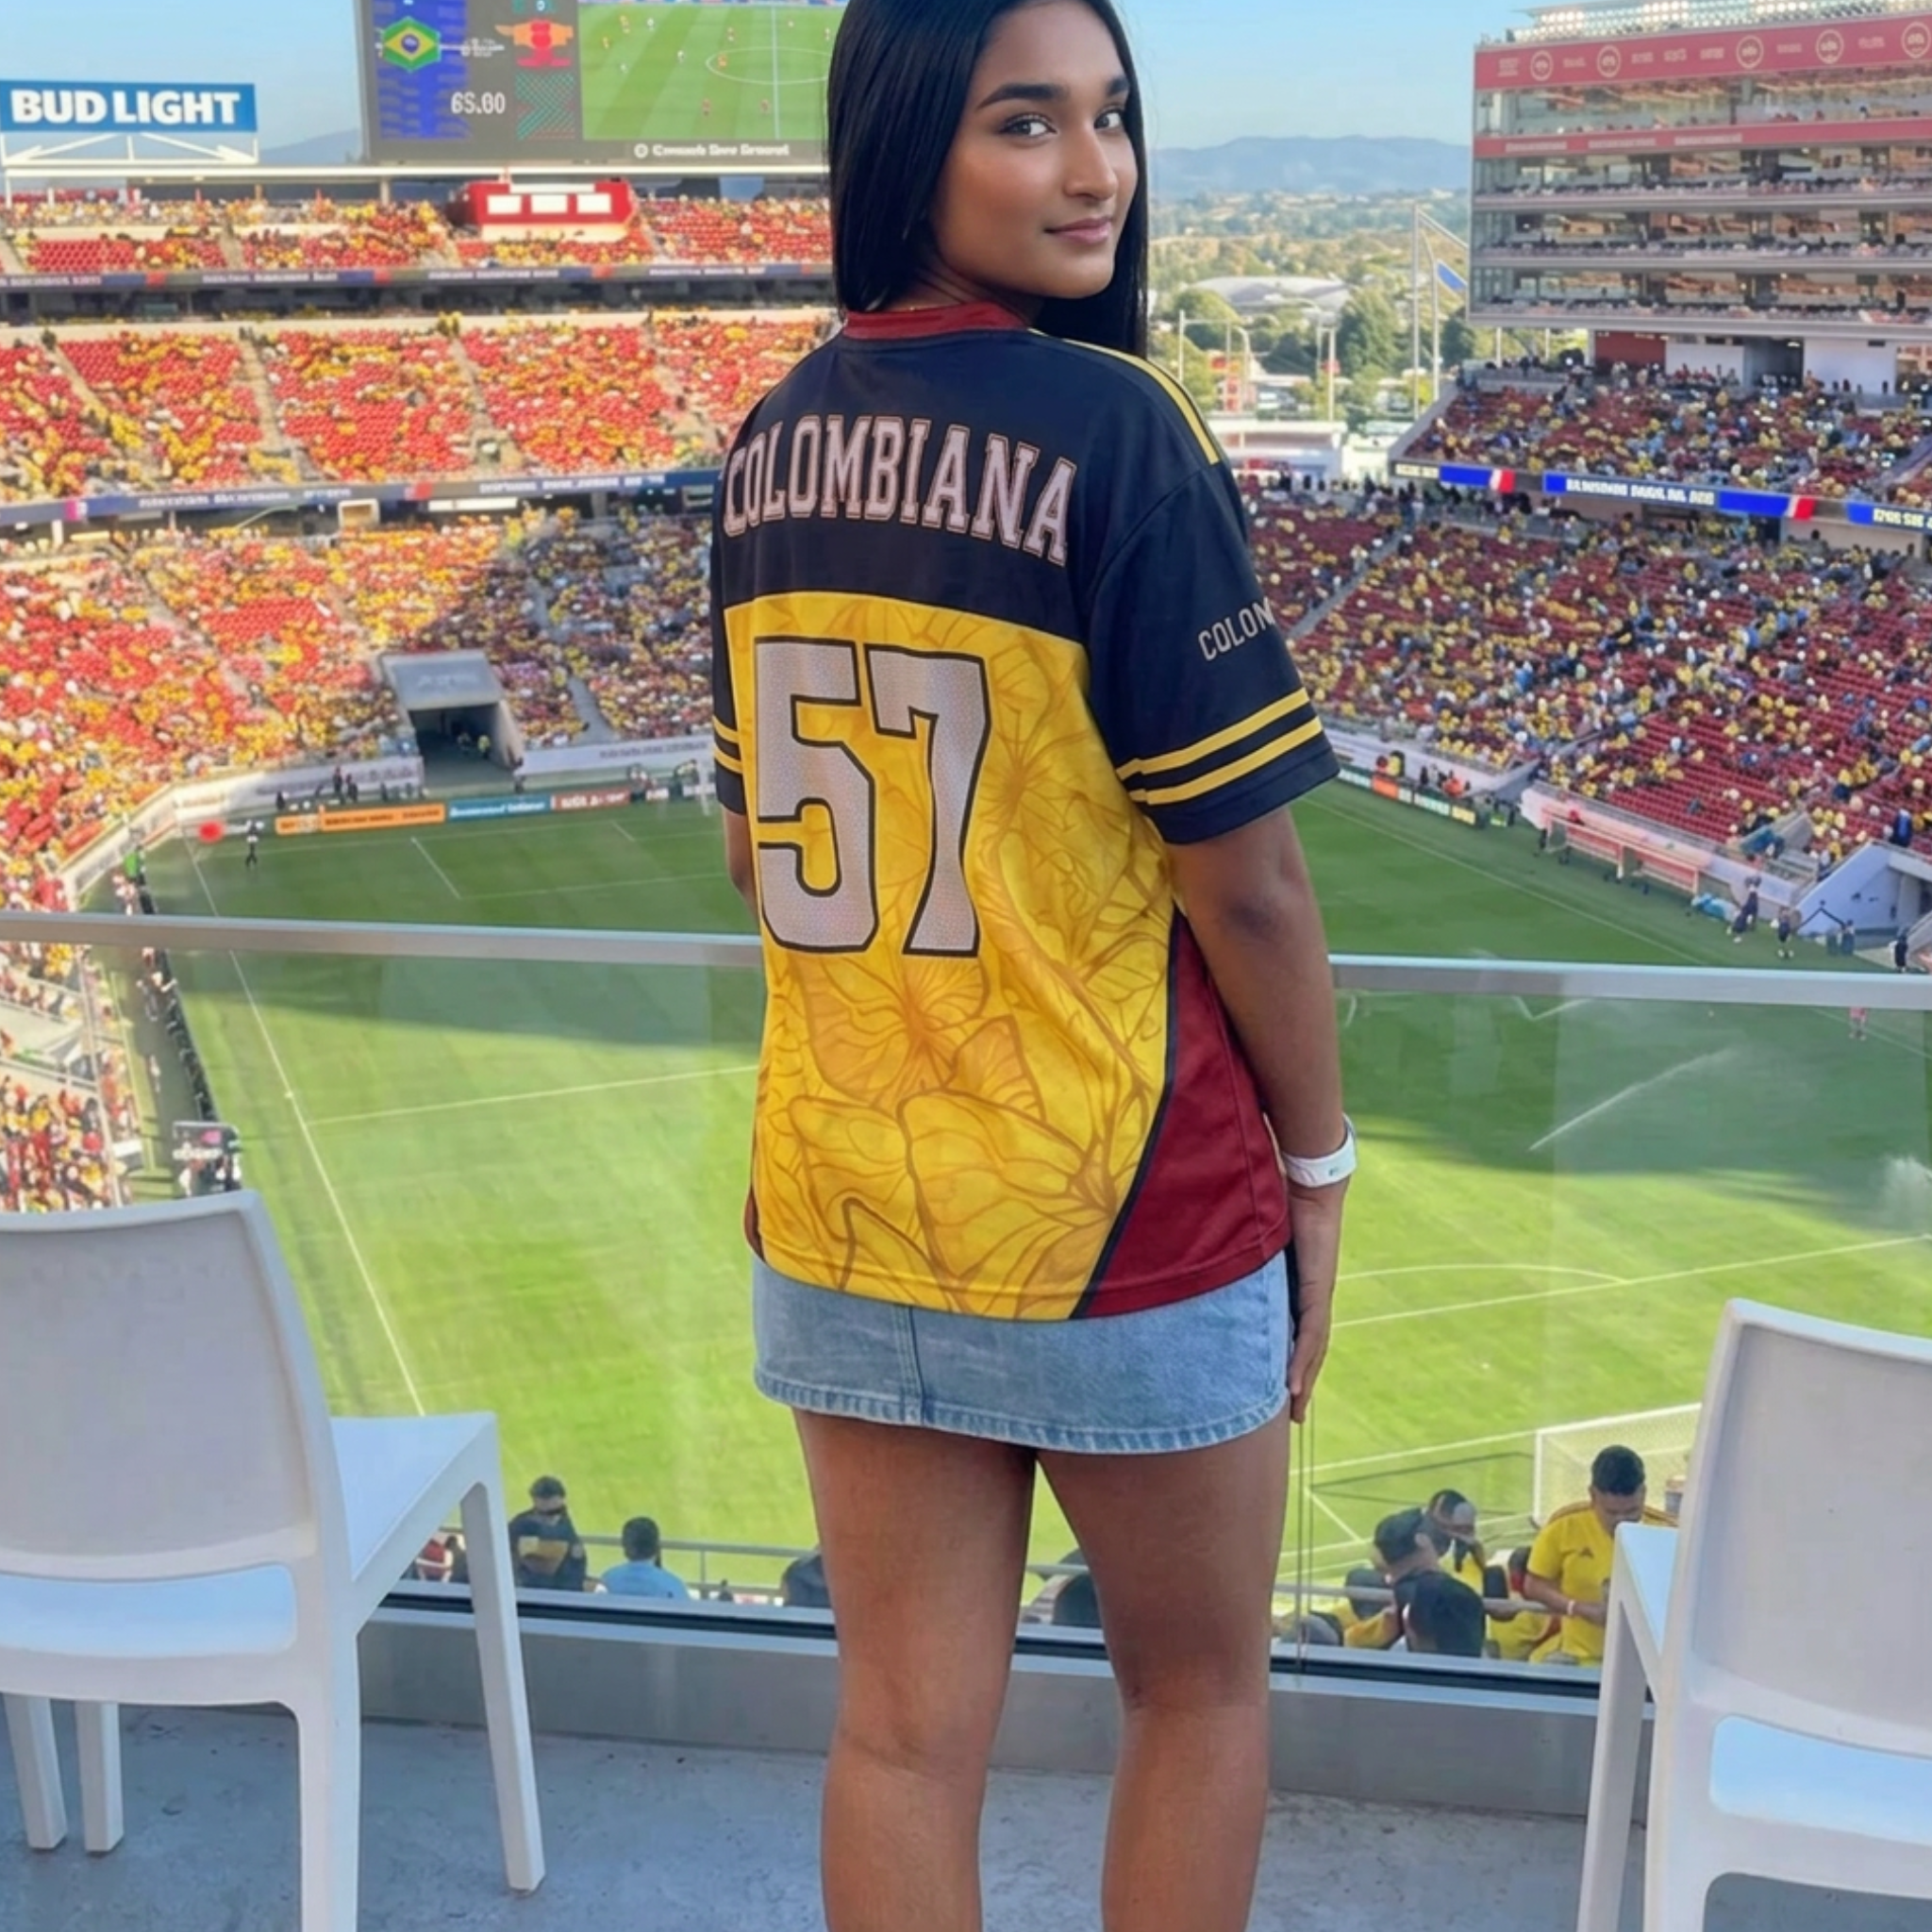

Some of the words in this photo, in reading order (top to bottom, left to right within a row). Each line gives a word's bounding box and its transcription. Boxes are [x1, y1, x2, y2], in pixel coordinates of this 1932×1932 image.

[10, 90, 108, 124] BUD
[112, 91, 241, 125] LIGHT
[723, 413, 1077, 567] COLOMBIANA
[755, 636, 991, 957] 57
